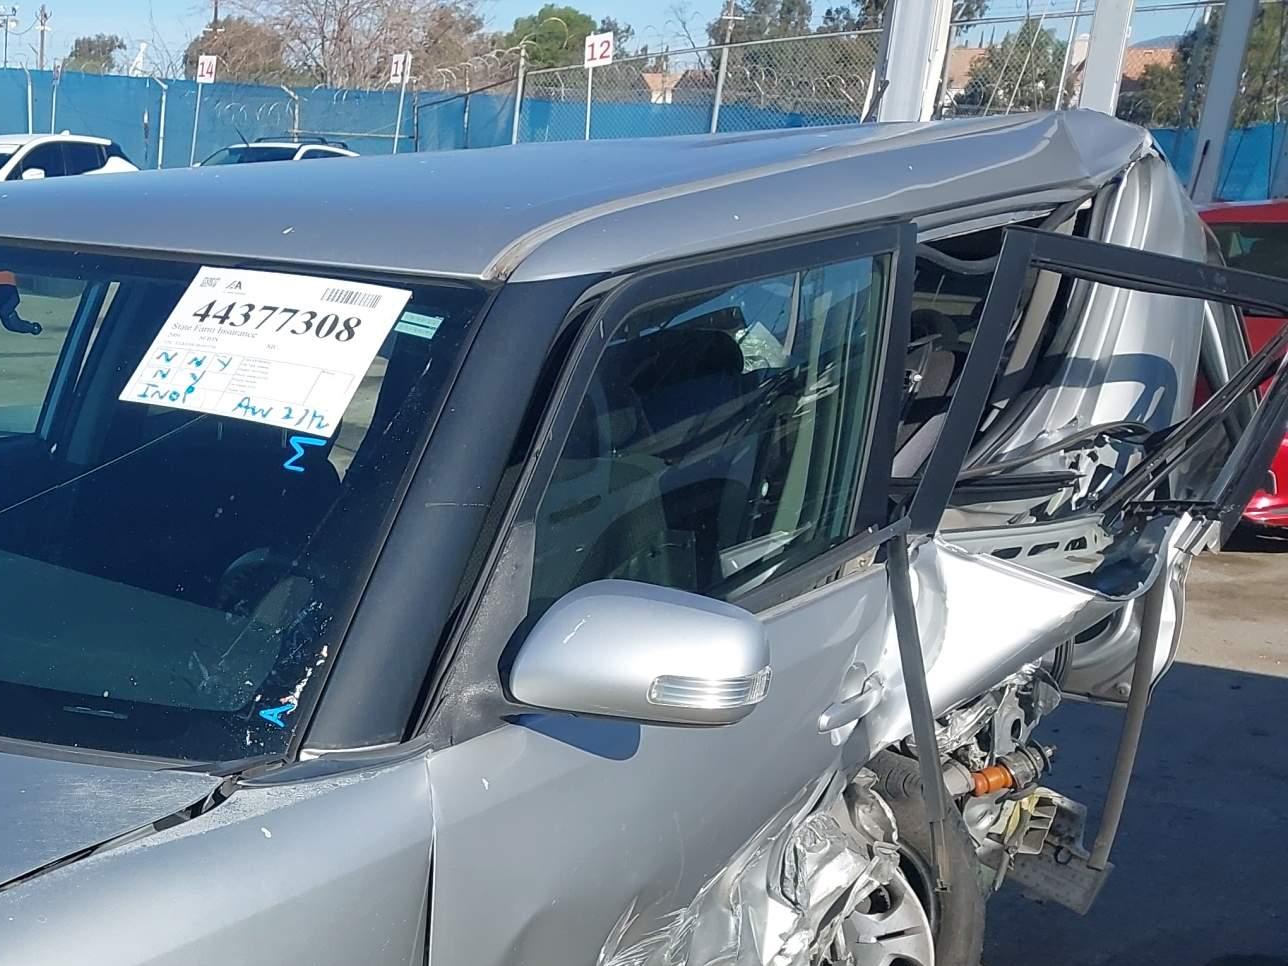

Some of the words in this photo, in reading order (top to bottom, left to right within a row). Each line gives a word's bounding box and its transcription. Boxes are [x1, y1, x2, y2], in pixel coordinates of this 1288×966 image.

[587, 40, 611, 61] 12
[199, 62, 213, 77] 14
[172, 322, 193, 331] State
[194, 325, 217, 333] Farm
[217, 327, 258, 338] Insurance
[192, 300, 362, 342] 44377308
